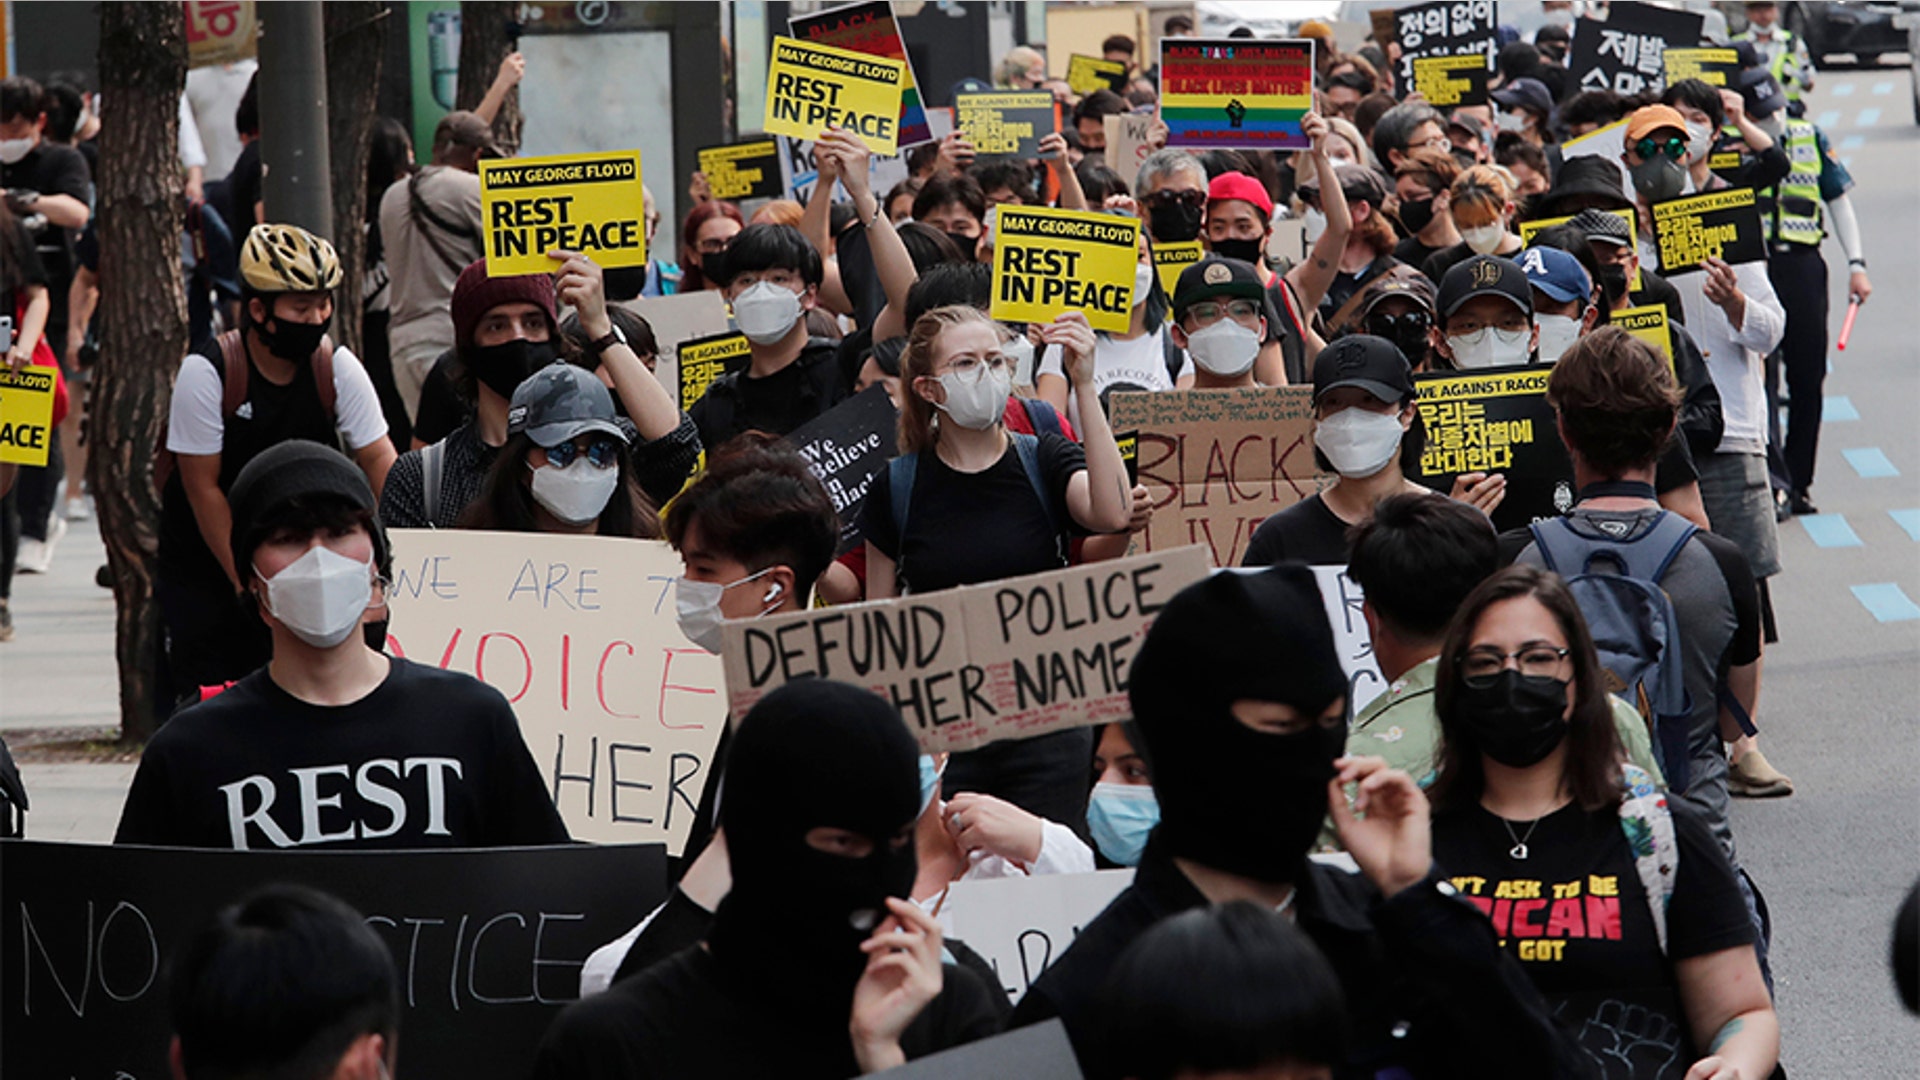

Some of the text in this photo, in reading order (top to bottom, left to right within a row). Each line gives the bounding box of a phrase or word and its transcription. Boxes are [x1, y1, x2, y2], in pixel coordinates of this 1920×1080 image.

[808, 11, 878, 39] BLACK
[1399, 1, 1494, 48] 정의 없이
[778, 48, 899, 81] MAY GEORGE FLOYD
[1597, 29, 1667, 76] 제발
[775, 72, 844, 106] REST
[1168, 79, 1304, 95] BLACK LIVES MATTER
[772, 97, 802, 123] IN
[807, 103, 893, 140] PEACE
[488, 162, 634, 186] MAY GEORGE FLOYD
[491, 196, 574, 229] REST
[1655, 207, 1669, 217] WE
[1673, 200, 1714, 213] AGAINST
[493, 220, 640, 258] IN PEACE
[1003, 217, 1133, 243] MAY GEORGE FLOYD
[1003, 245, 1081, 278] REST
[1164, 251, 1198, 262] FLOYD
[1001, 274, 1130, 315] IN PEACE
[1625, 314, 1662, 328] FLOYD
[1416, 376, 1547, 399] WE AGAINST RACIS
[1418, 402, 1486, 428] 우리는
[799, 439, 836, 464] We
[808, 432, 882, 481] Believe
[1138, 432, 1307, 510] BLACK
[391, 557, 458, 600] WE
[508, 559, 601, 610] ARE
[743, 605, 945, 688] DEFUND
[996, 563, 1168, 643] POLICE
[890, 663, 997, 729] HER
[1012, 635, 1133, 710] NAME
[553, 734, 699, 830] HER
[217, 756, 464, 850] REST
[1494, 880, 1542, 899] ASK
[1552, 880, 1581, 899] TO
[1588, 874, 1619, 897] BE
[20, 900, 158, 1018] NO
[1519, 939, 1567, 961] GOT
